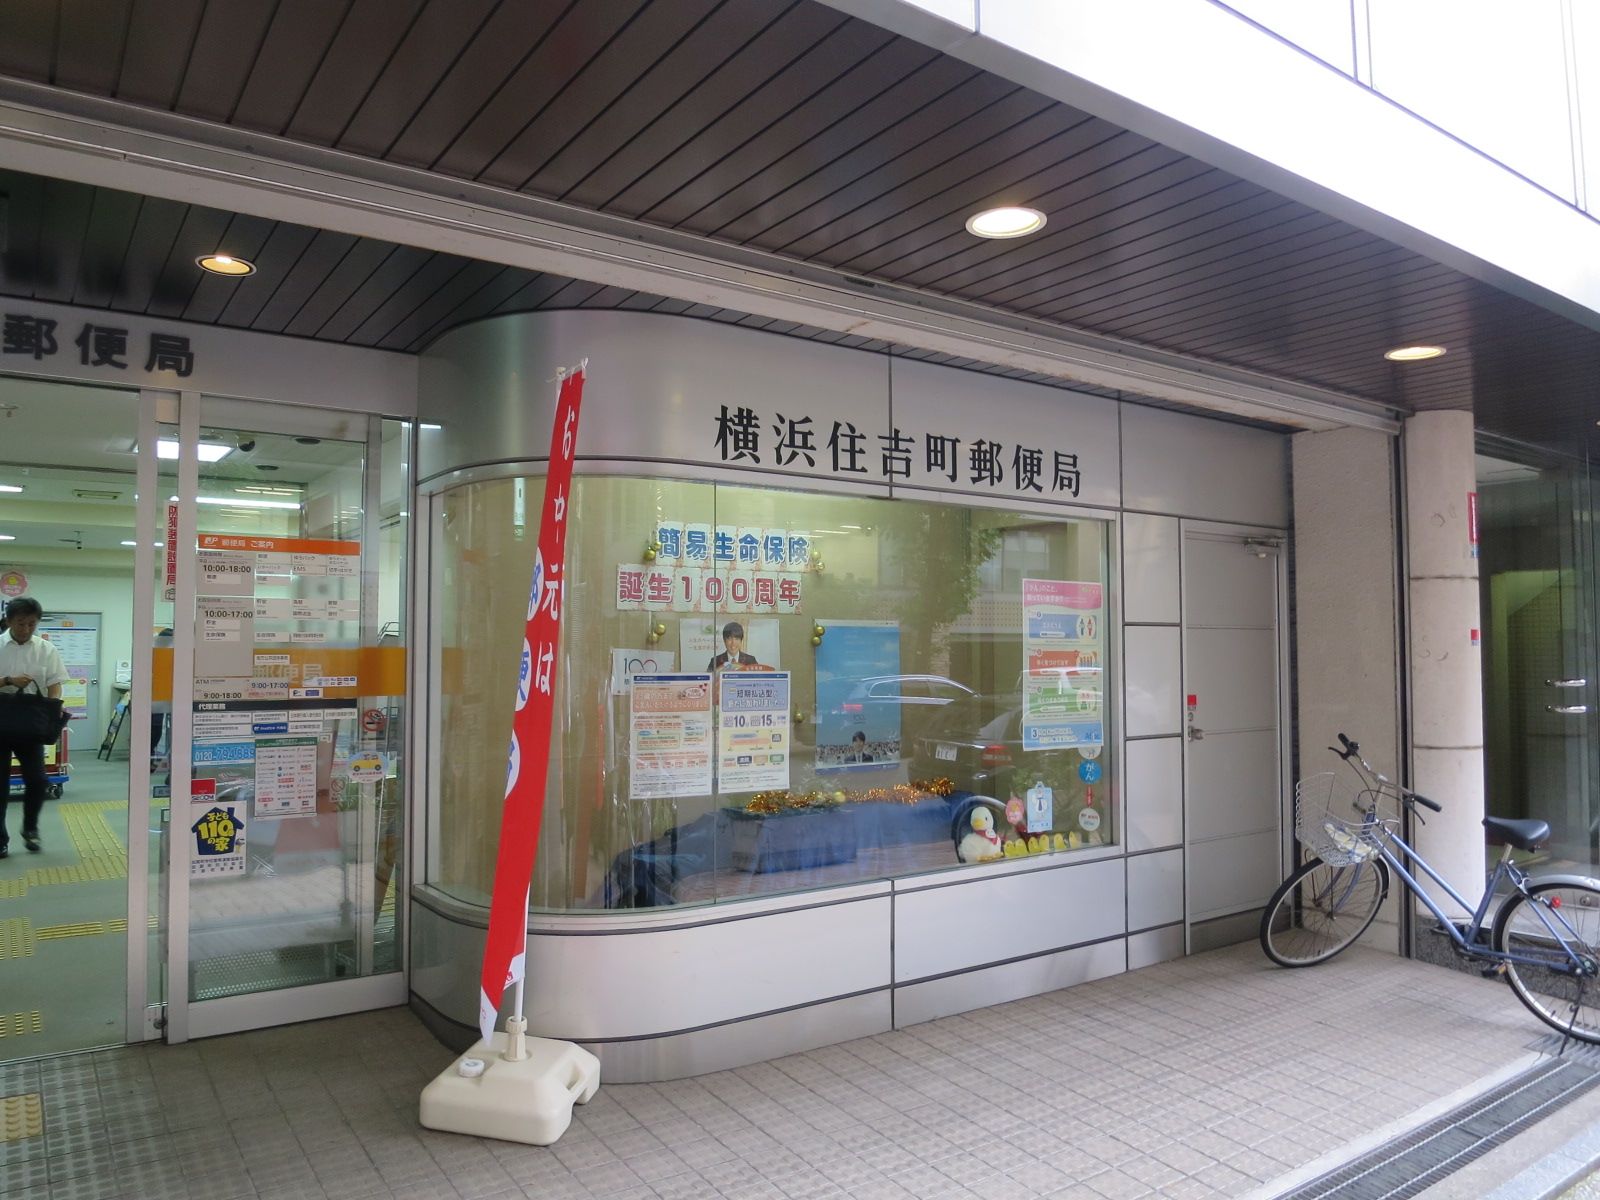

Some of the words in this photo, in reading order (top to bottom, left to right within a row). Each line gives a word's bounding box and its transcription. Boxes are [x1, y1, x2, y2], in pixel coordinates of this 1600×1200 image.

[3, 312, 195, 378] 郵便局
[714, 404, 1082, 498] 横浜住吉町郵便局
[657, 527, 811, 564] 簡易生命保険
[203, 564, 252, 574] 10:00-18:00
[618, 570, 801, 606] 誕生100周年
[204, 610, 254, 619] 10:00-17:00
[251, 682, 289, 690] 9:00-17:00
[203, 692, 242, 700] 9:00-18:00
[734, 715, 746, 728] 10
[761, 714, 773, 727] 15
[207, 811, 229, 822] 子ども
[207, 837, 230, 852] の家
